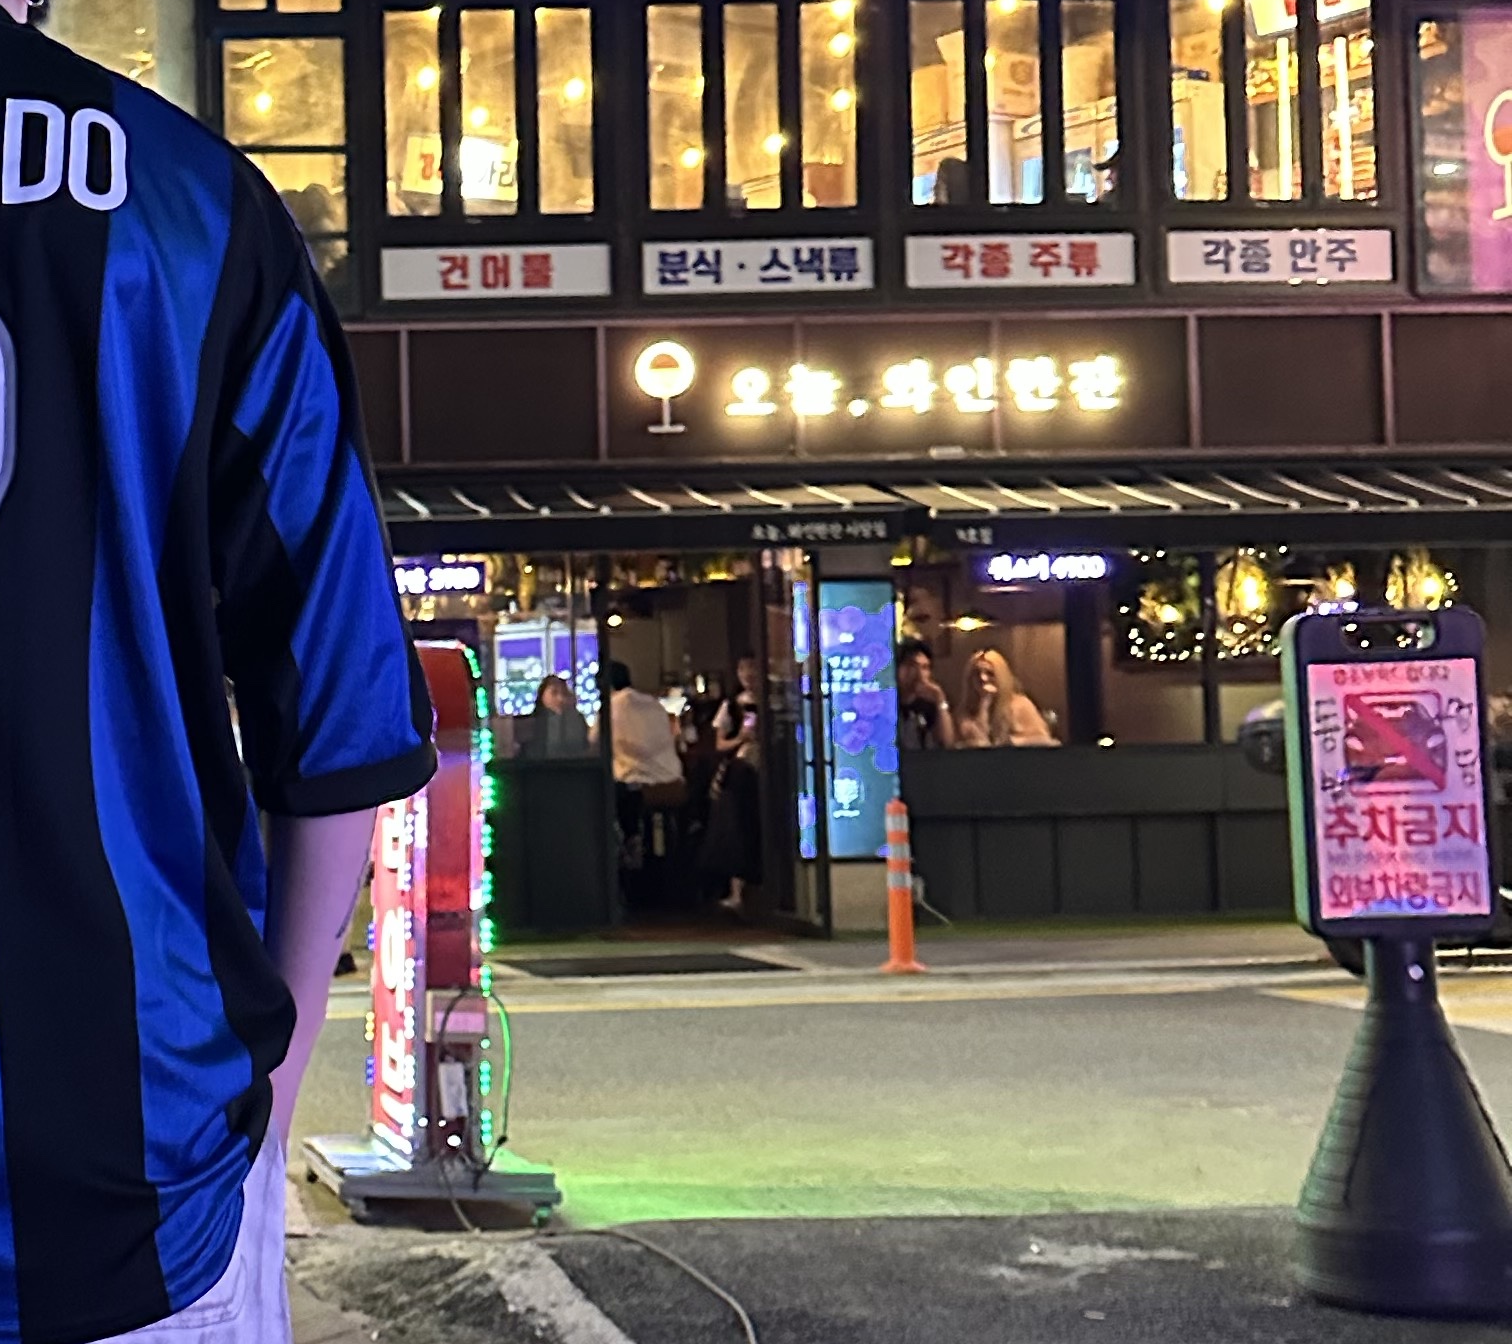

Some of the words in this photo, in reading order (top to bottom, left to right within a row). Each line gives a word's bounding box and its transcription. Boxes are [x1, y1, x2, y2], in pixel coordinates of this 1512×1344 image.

[438, 253, 554, 291] 건어물
[941, 242, 1012, 279] 각종
[1028, 241, 1100, 277] 주류
[1202, 238, 1273, 275] 각종
[1323, 804, 1479, 847] 주차금지
